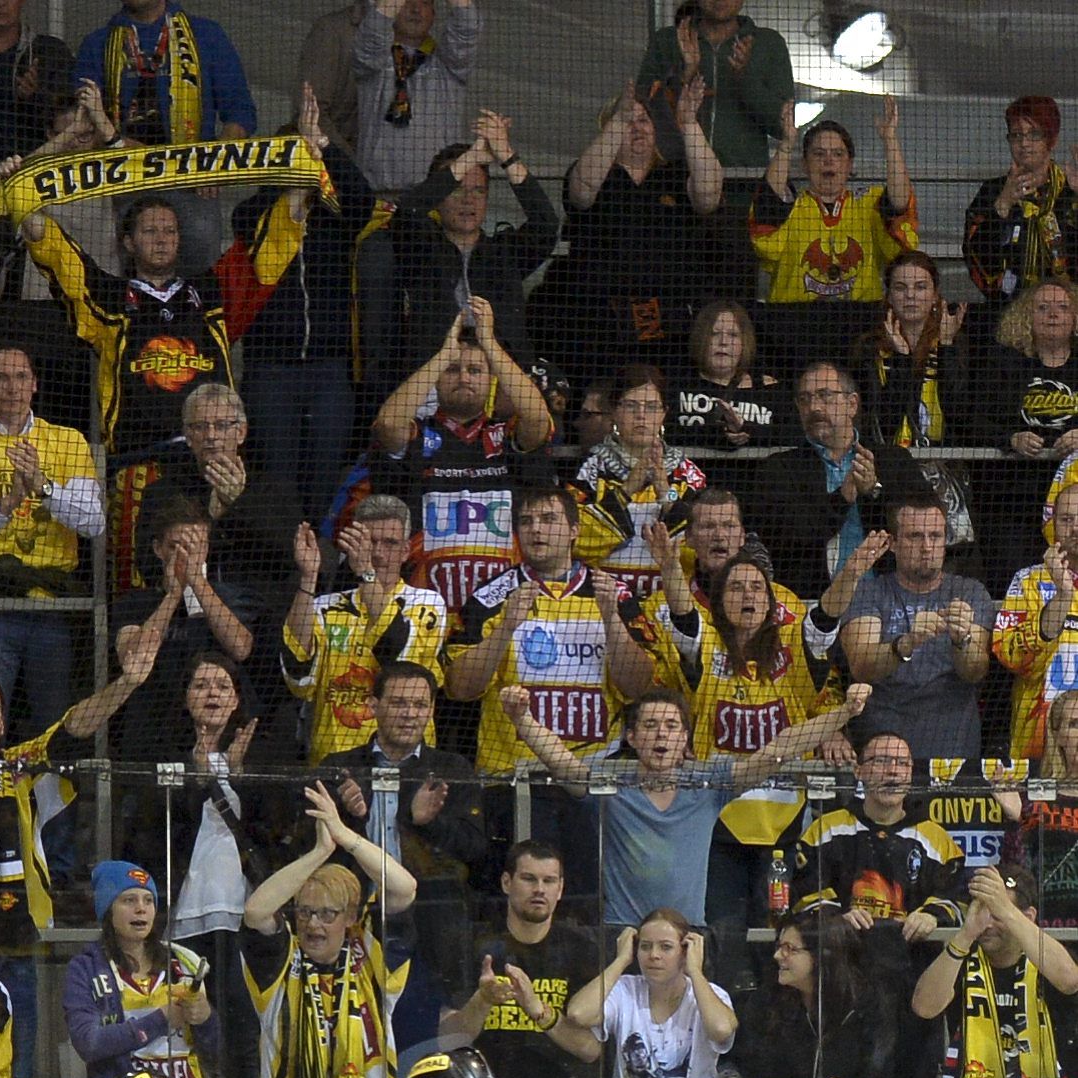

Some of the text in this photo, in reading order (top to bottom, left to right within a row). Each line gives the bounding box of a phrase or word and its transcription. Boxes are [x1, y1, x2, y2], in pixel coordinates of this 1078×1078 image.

[33, 139, 301, 202] FINALS 2015
[426, 500, 510, 538] UPC
[534, 689, 604, 739] TEFFL
